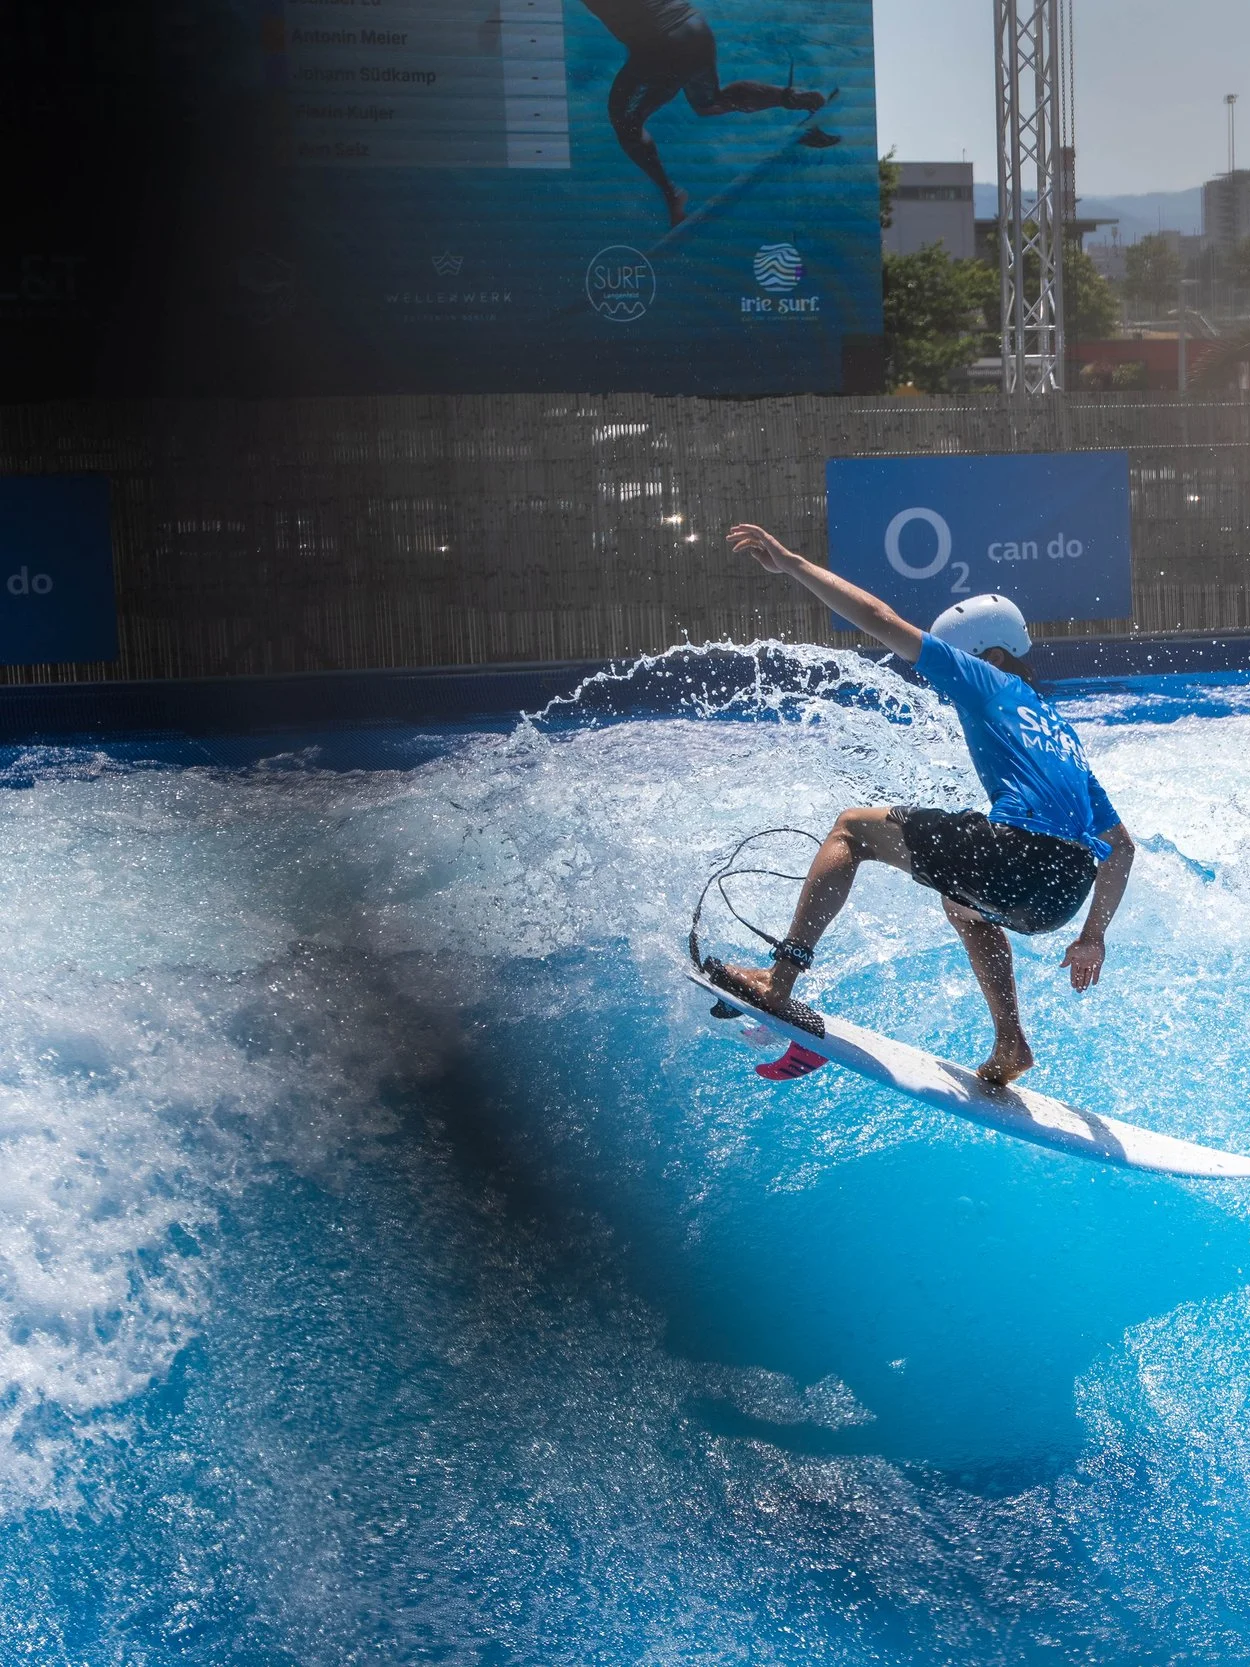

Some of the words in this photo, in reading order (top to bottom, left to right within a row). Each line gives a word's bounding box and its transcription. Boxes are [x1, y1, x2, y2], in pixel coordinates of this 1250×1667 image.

[292, 29, 356, 44] Antonin
[361, 29, 408, 45] Meier
[293, 64, 355, 81] Johann
[360, 66, 437, 86] Südkamp
[594, 265, 647, 289] SURF
[383, 291, 513, 304] WELLENWERK
[741, 296, 773, 312] irie
[777, 296, 821, 314] surf.
[987, 539, 1039, 562] can
[1047, 532, 1084, 559] do
[6, 567, 54, 595] do
